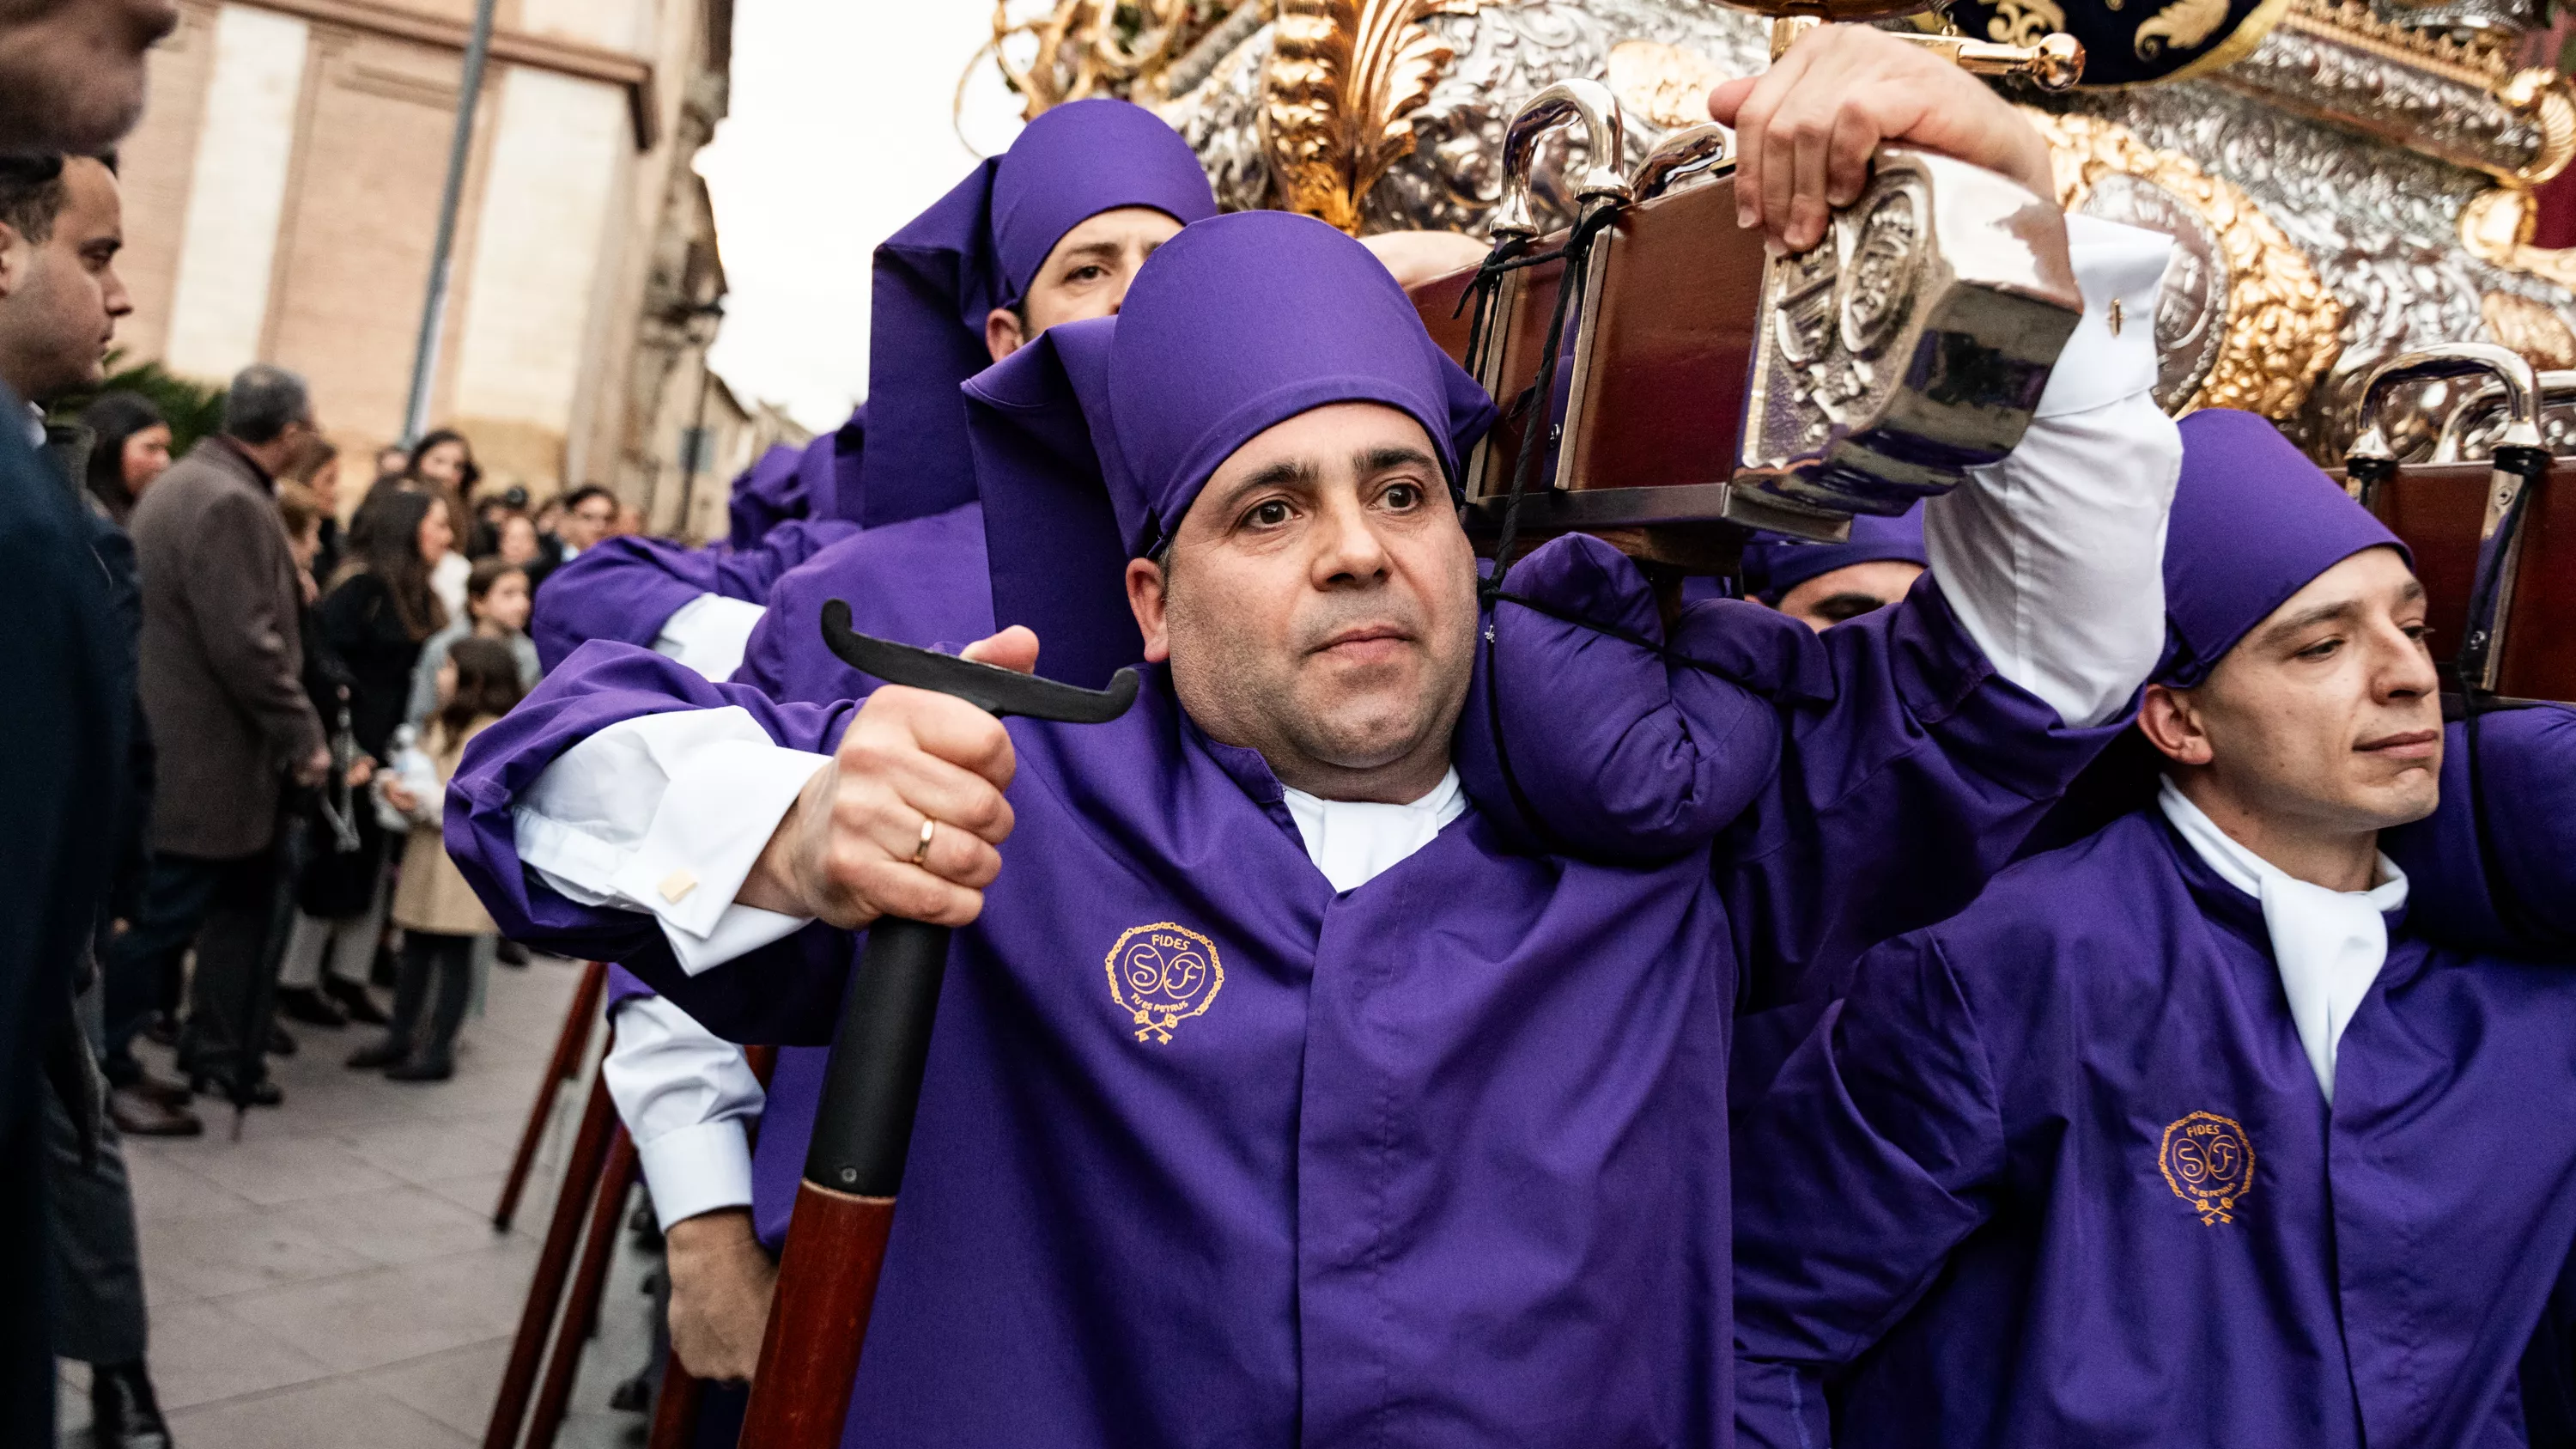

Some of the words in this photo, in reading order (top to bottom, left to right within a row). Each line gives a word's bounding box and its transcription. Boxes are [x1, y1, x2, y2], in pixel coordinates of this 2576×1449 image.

[1151, 935, 1190, 951] FIDES
[1131, 993, 1144, 1005] TU
[1154, 1001, 1188, 1013] PETRUS
[2186, 1124, 2221, 1137] FIDES
